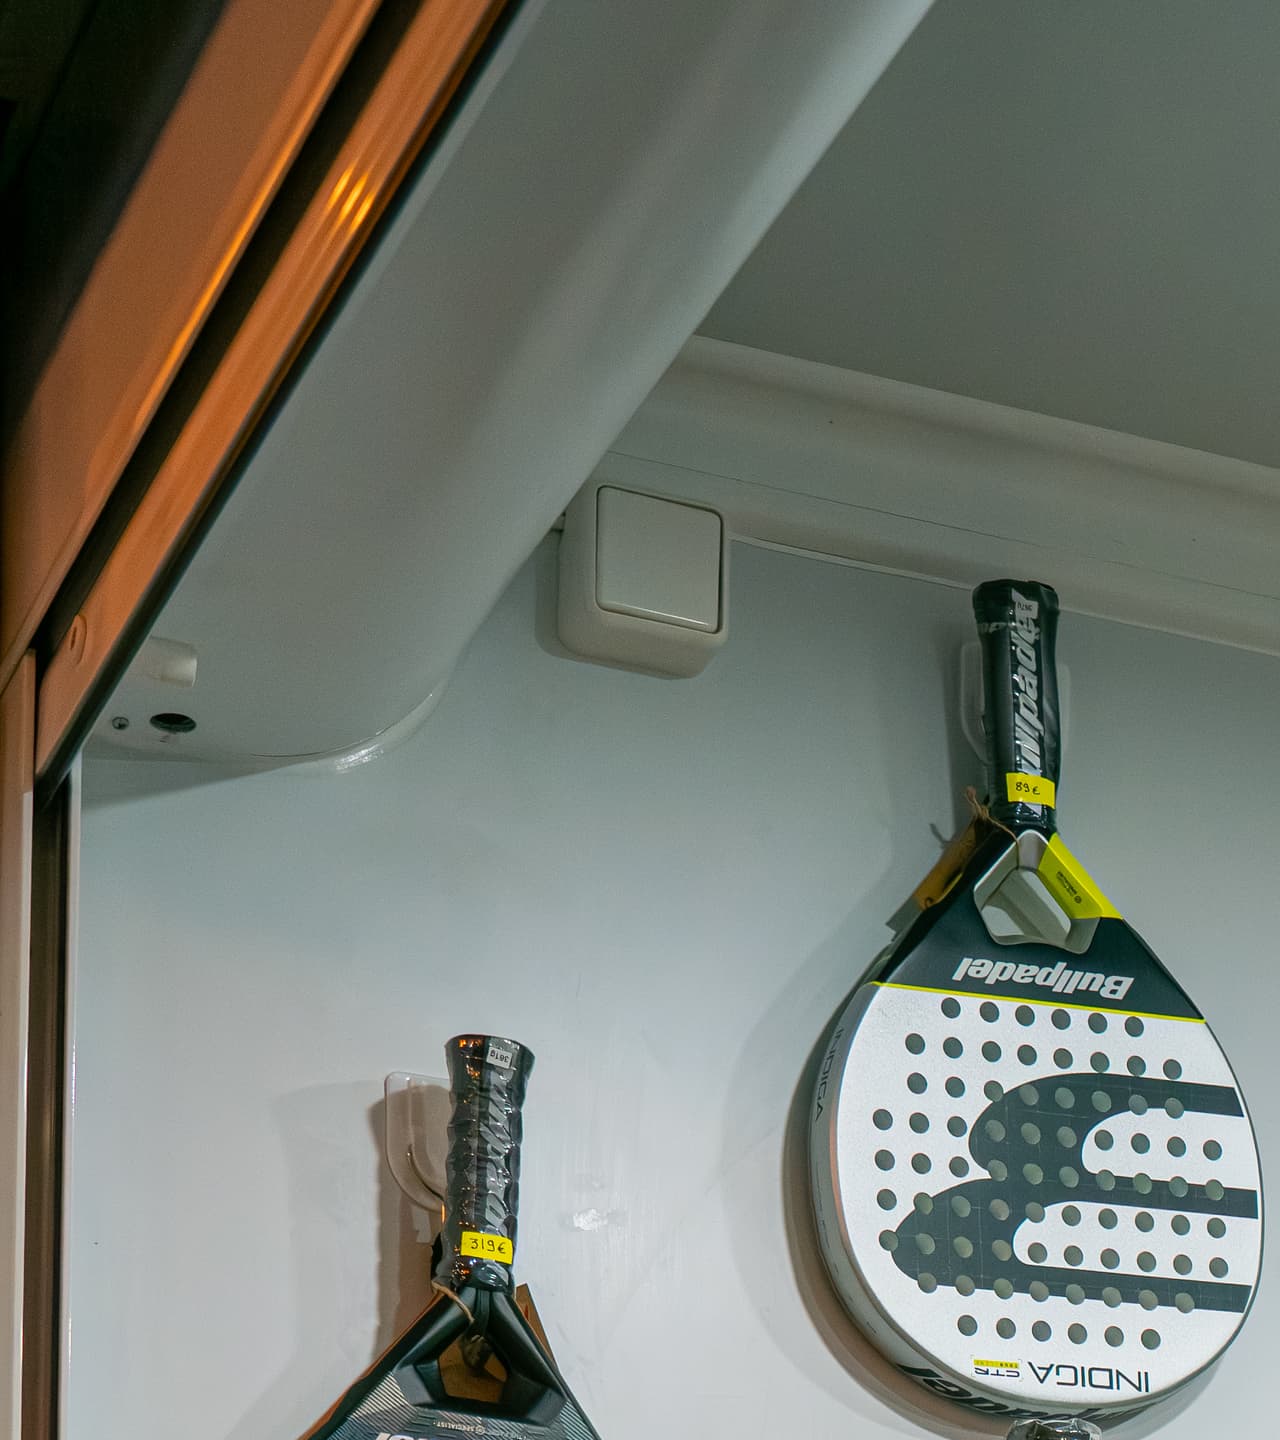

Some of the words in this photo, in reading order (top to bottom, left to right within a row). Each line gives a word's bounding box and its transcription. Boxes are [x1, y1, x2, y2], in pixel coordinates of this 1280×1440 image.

[951, 957, 1135, 1001] Bullpadel
[470, 1238, 506, 1254] 319€
[1027, 1361, 1150, 1394] INDIGA
